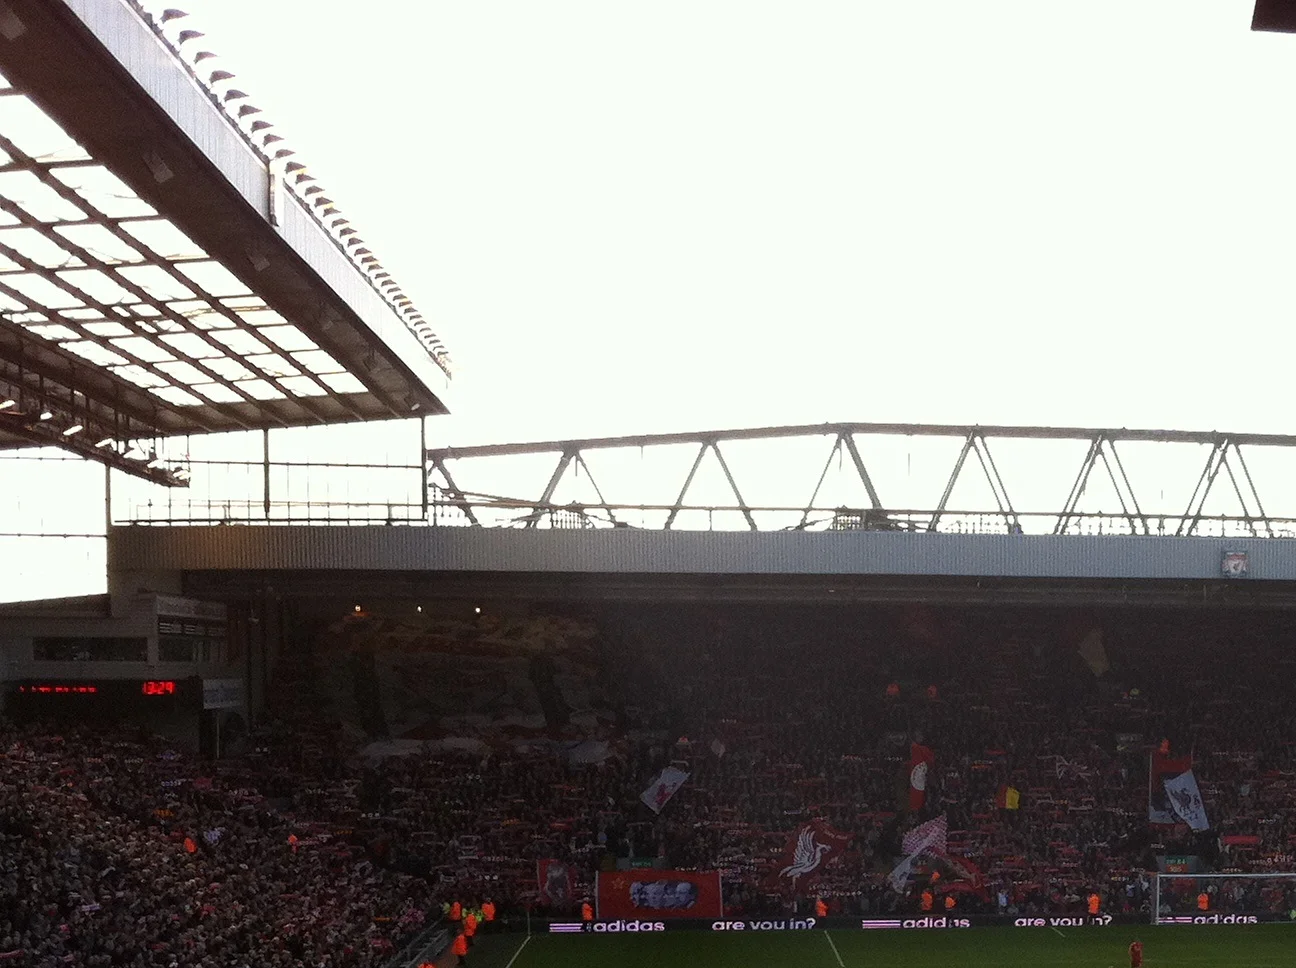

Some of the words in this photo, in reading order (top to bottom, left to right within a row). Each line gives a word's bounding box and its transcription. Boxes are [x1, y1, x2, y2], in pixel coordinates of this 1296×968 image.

[592, 920, 665, 931] adidas
[711, 921, 745, 931] are
[750, 920, 784, 931] you
[790, 917, 816, 930] in?
[1014, 917, 1047, 927] are
[1050, 917, 1083, 927] you
